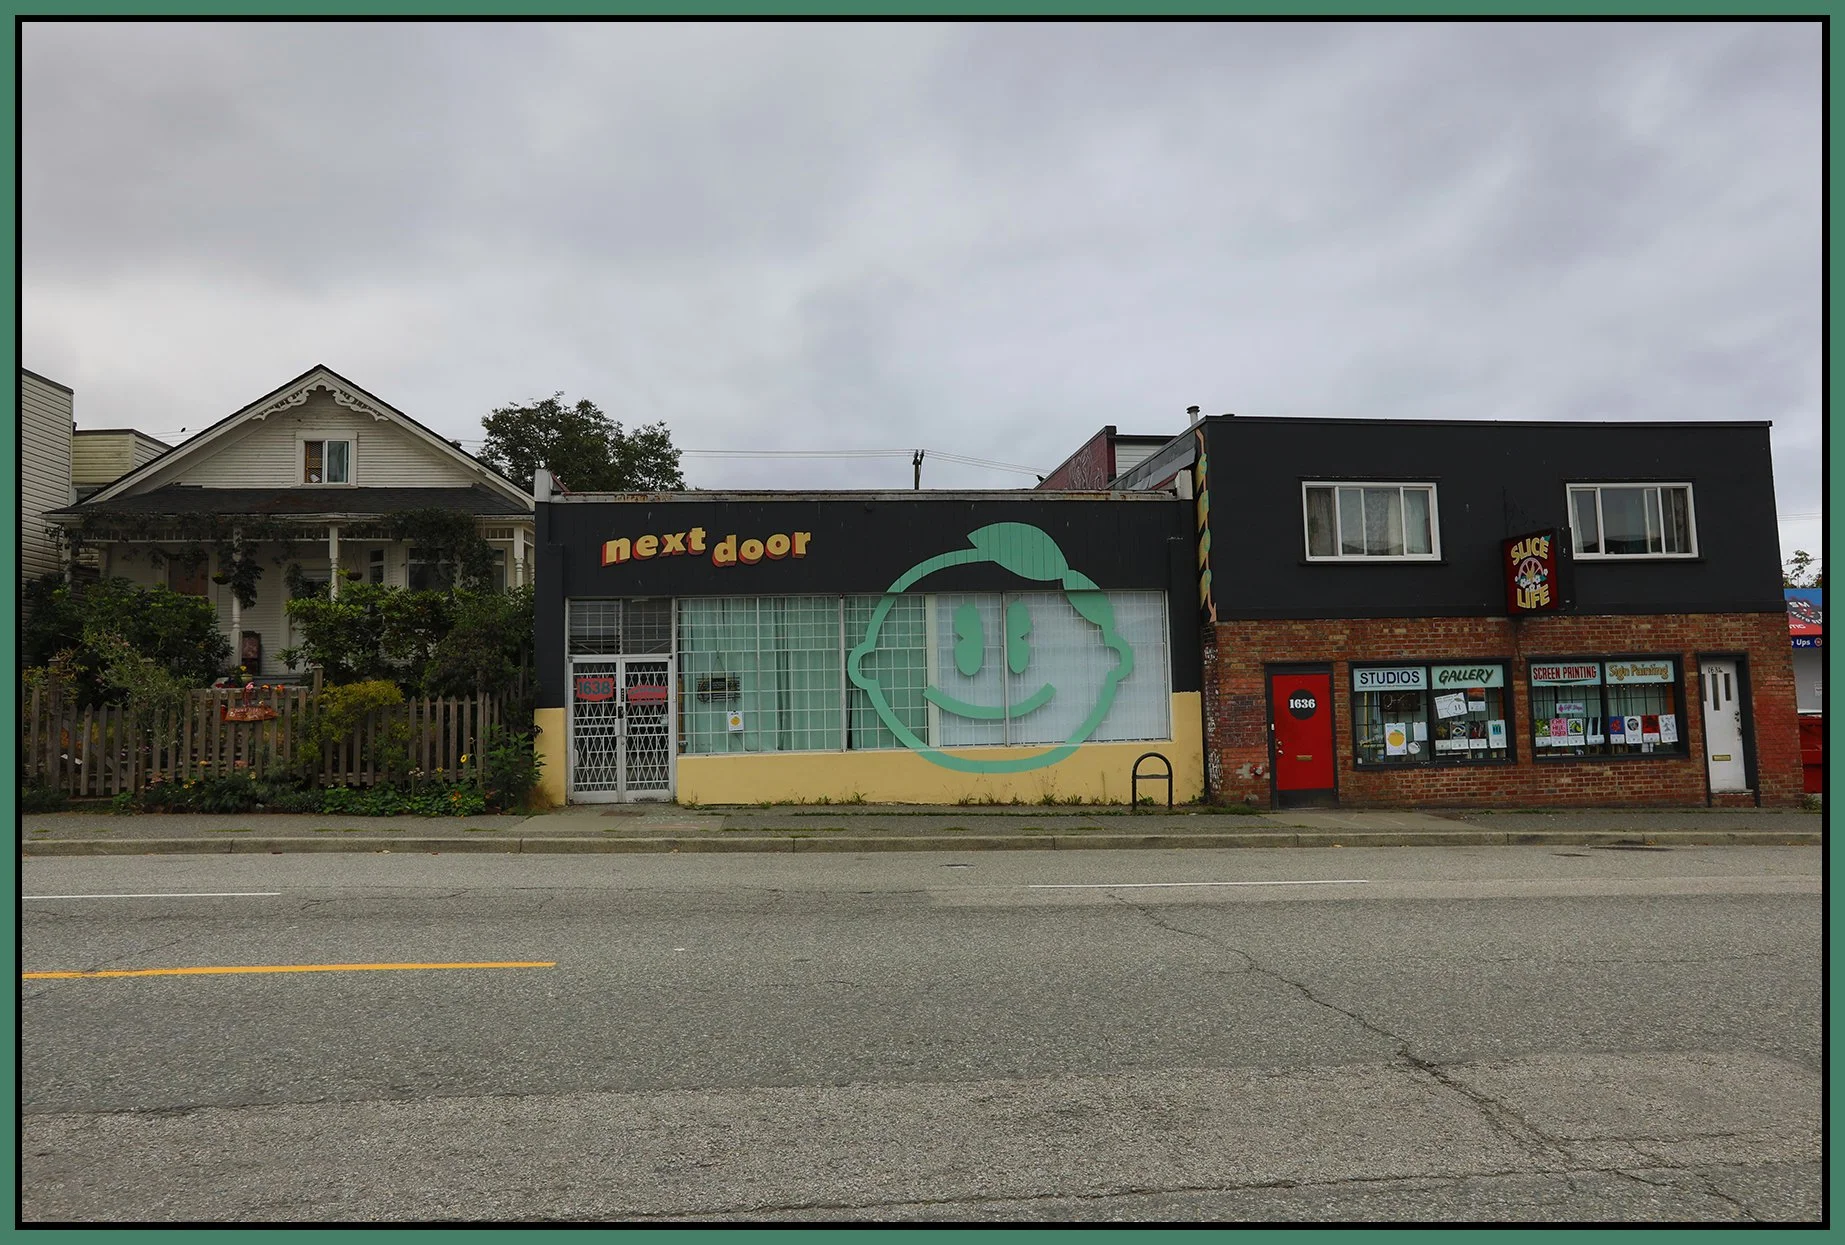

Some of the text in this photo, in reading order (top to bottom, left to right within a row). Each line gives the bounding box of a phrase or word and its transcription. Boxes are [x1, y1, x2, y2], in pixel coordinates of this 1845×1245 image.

[601, 527, 811, 568] next door
[1510, 537, 1550, 566] SLICE
[1517, 584, 1550, 609] LIFE
[1796, 638, 1810, 648] Ups
[1360, 671, 1420, 685] STUDIOS
[1438, 668, 1494, 685] GALLERY
[1533, 665, 1597, 680] SCREEN PRINTING
[1608, 664, 1669, 681] Sign Painting
[578, 680, 611, 695] 1638
[1289, 698, 1316, 709] 1636
